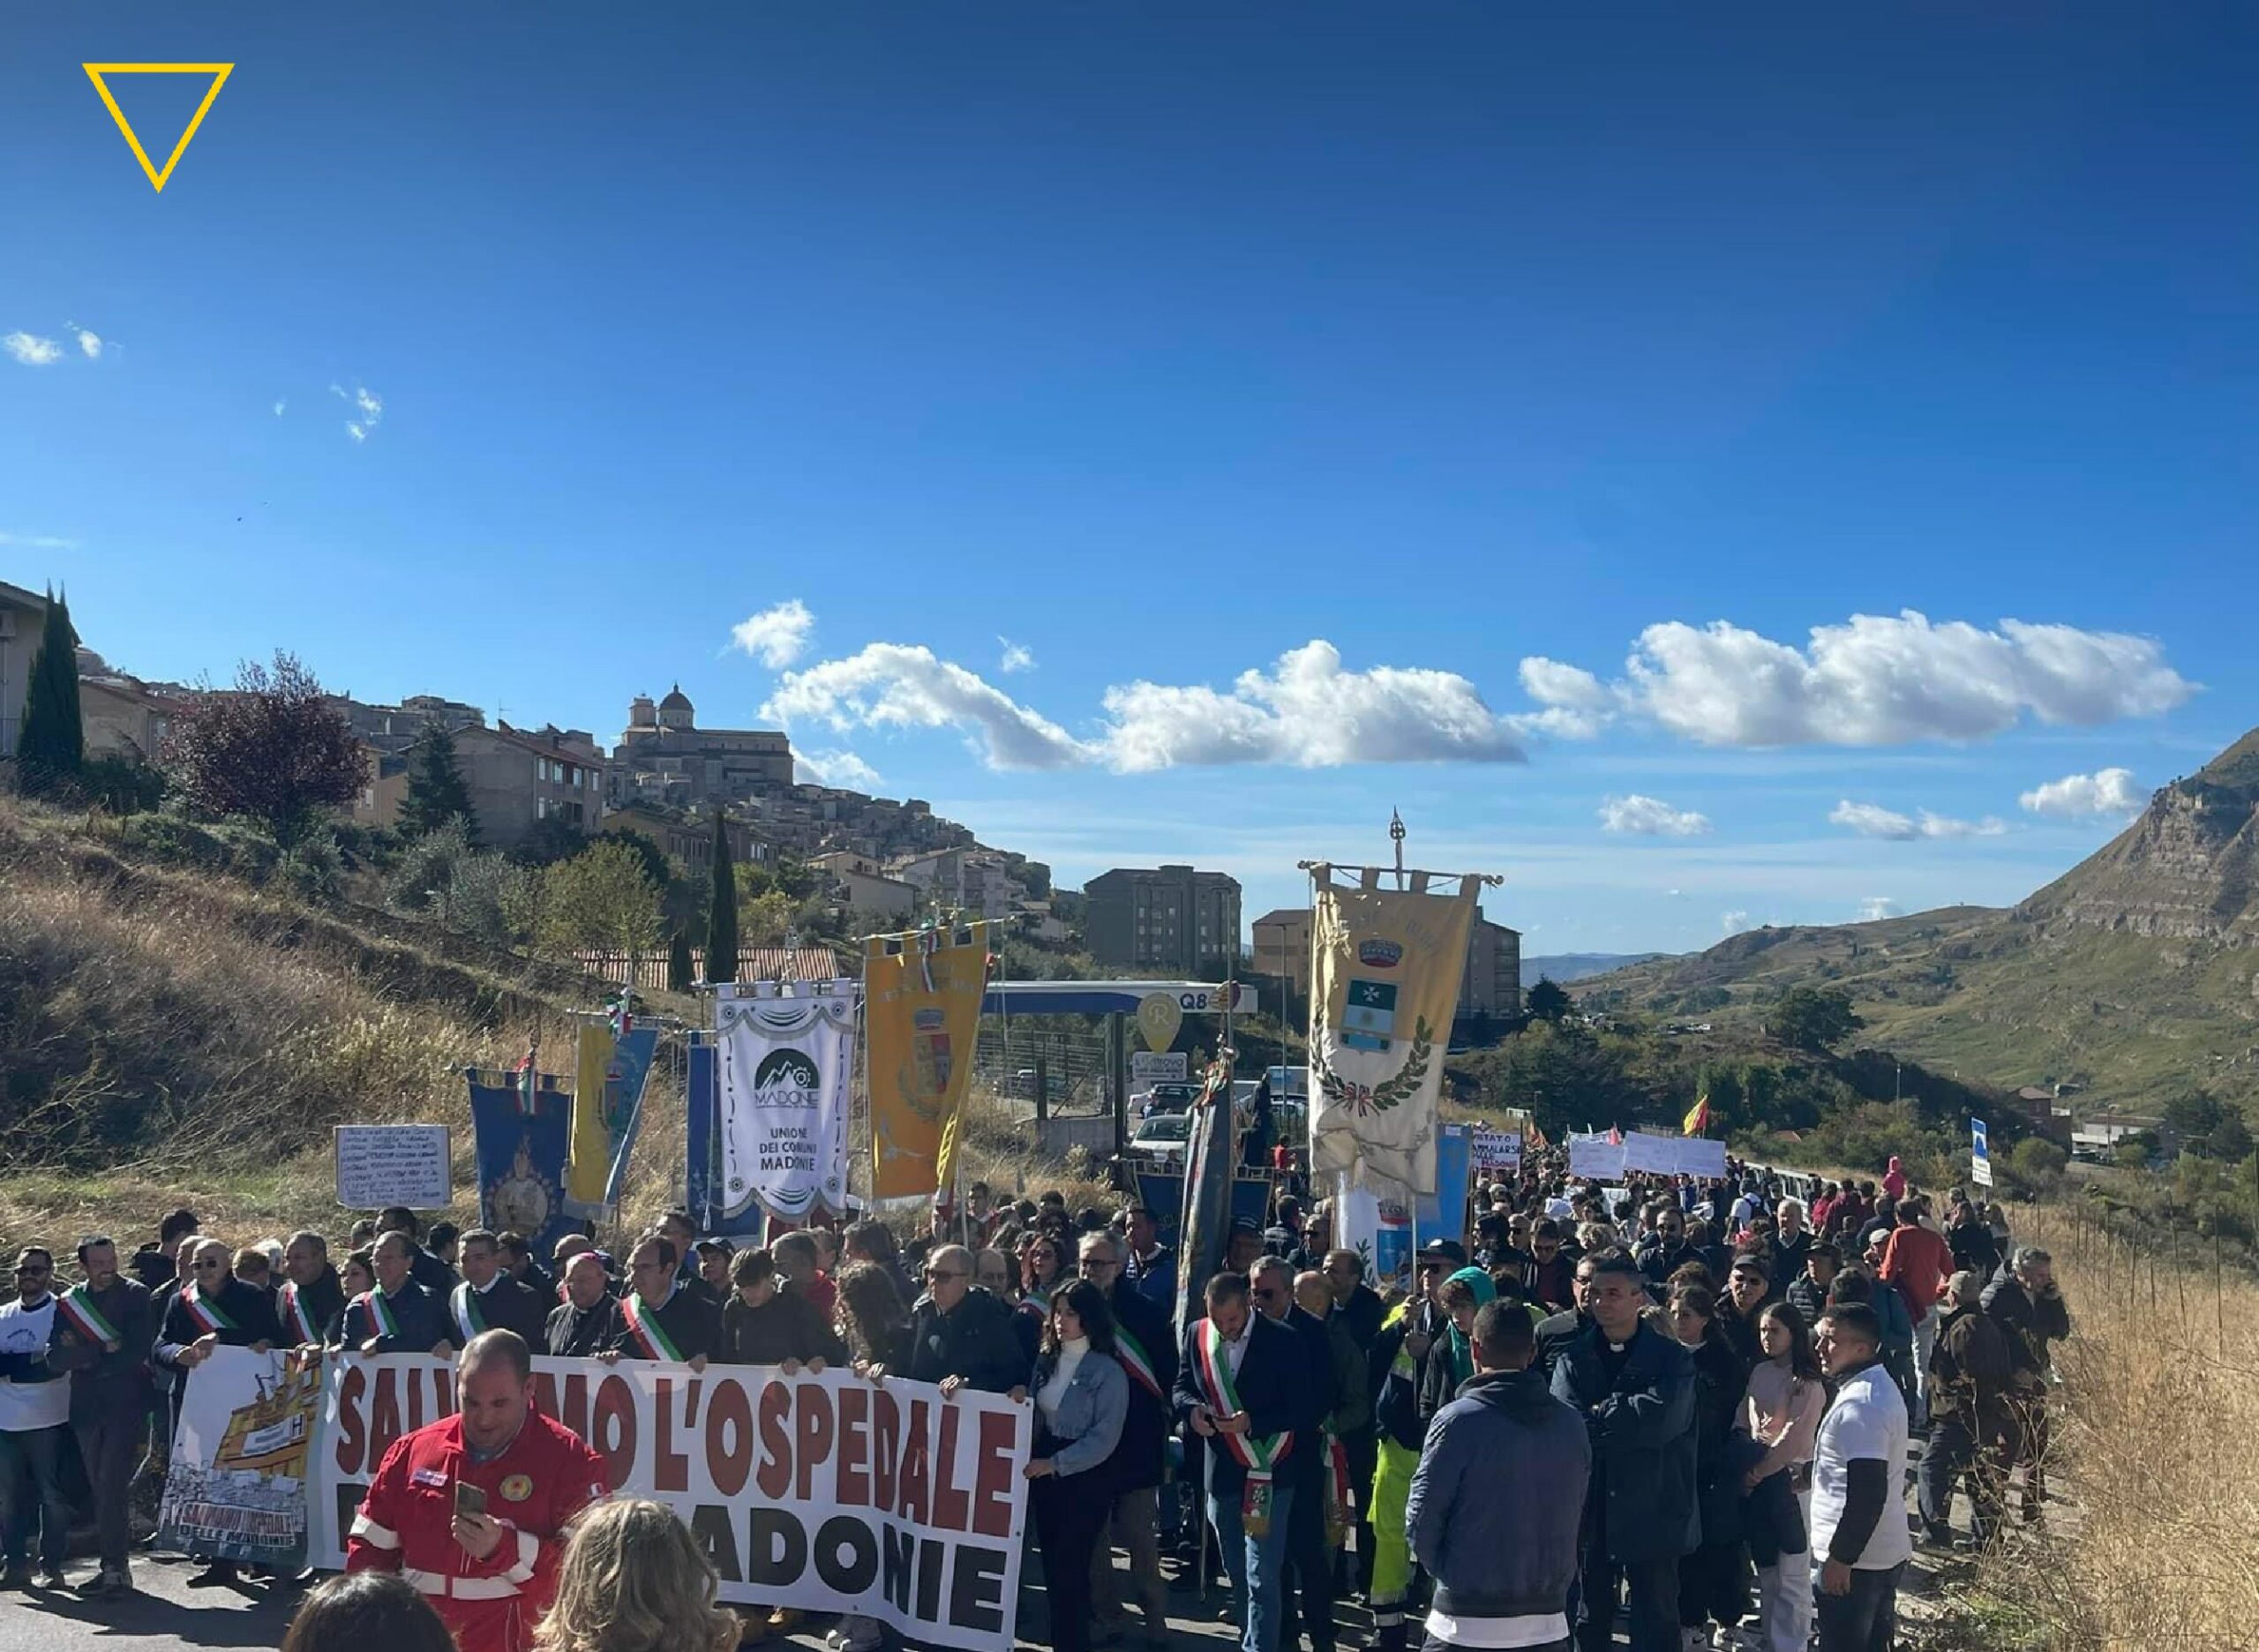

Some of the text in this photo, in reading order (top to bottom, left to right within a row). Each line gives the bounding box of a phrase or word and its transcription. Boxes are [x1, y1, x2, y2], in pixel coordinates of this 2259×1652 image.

[1180, 993, 1207, 1010] Q8
[769, 1127, 807, 1138] UNIONE
[759, 1142, 778, 1153] DEI
[760, 1156, 815, 1171] MADONIE
[655, 1378, 1017, 1538] L'OSPEDALE
[688, 1503, 1007, 1633] ADONIE
